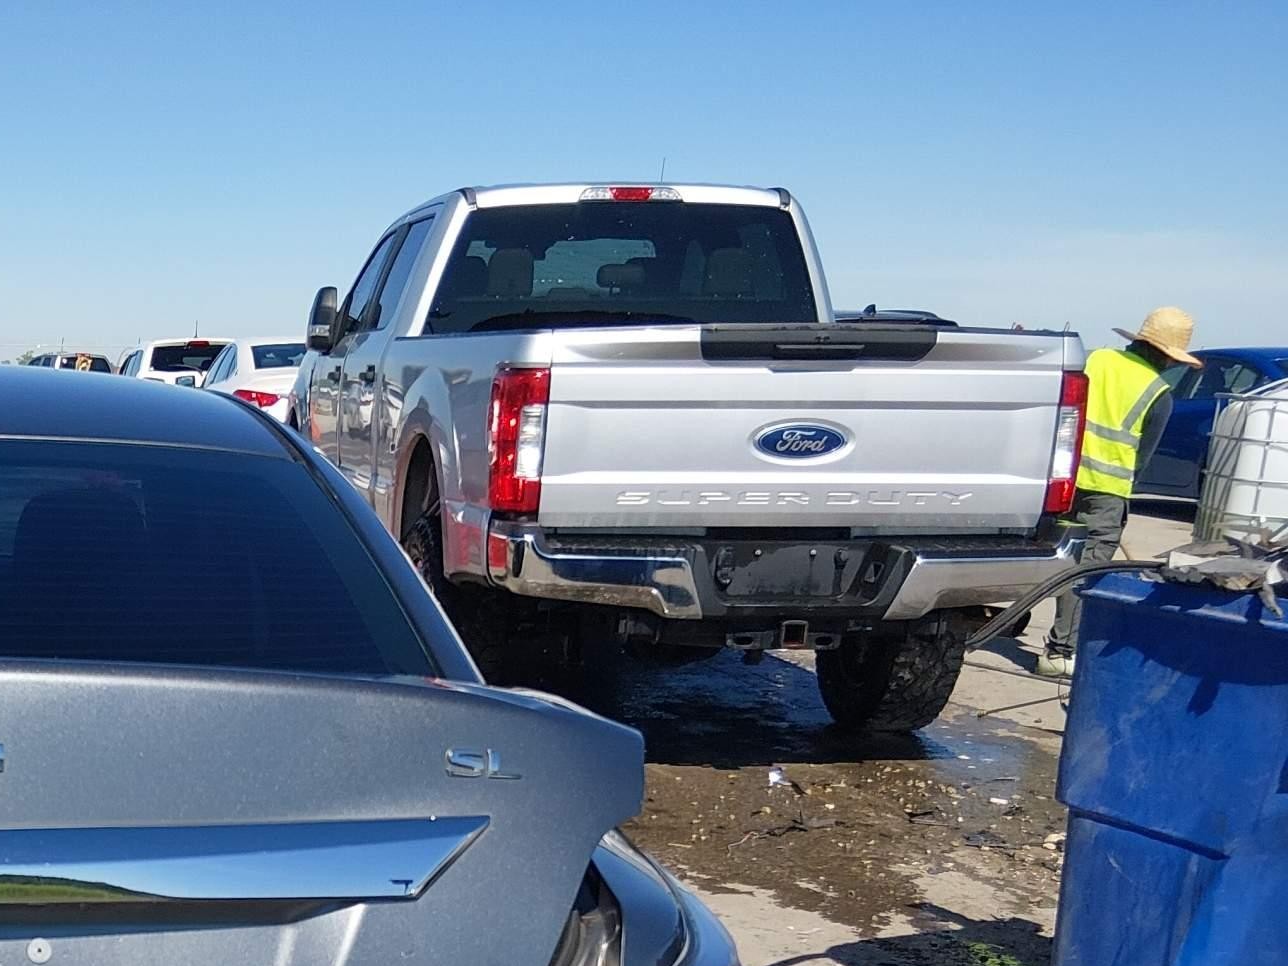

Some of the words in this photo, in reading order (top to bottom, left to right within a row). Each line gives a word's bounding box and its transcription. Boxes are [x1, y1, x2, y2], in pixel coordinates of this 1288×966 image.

[776, 430, 828, 451] Ford
[616, 490, 810, 505] SUPER
[825, 490, 973, 505] DUTY
[444, 749, 523, 780] SL
